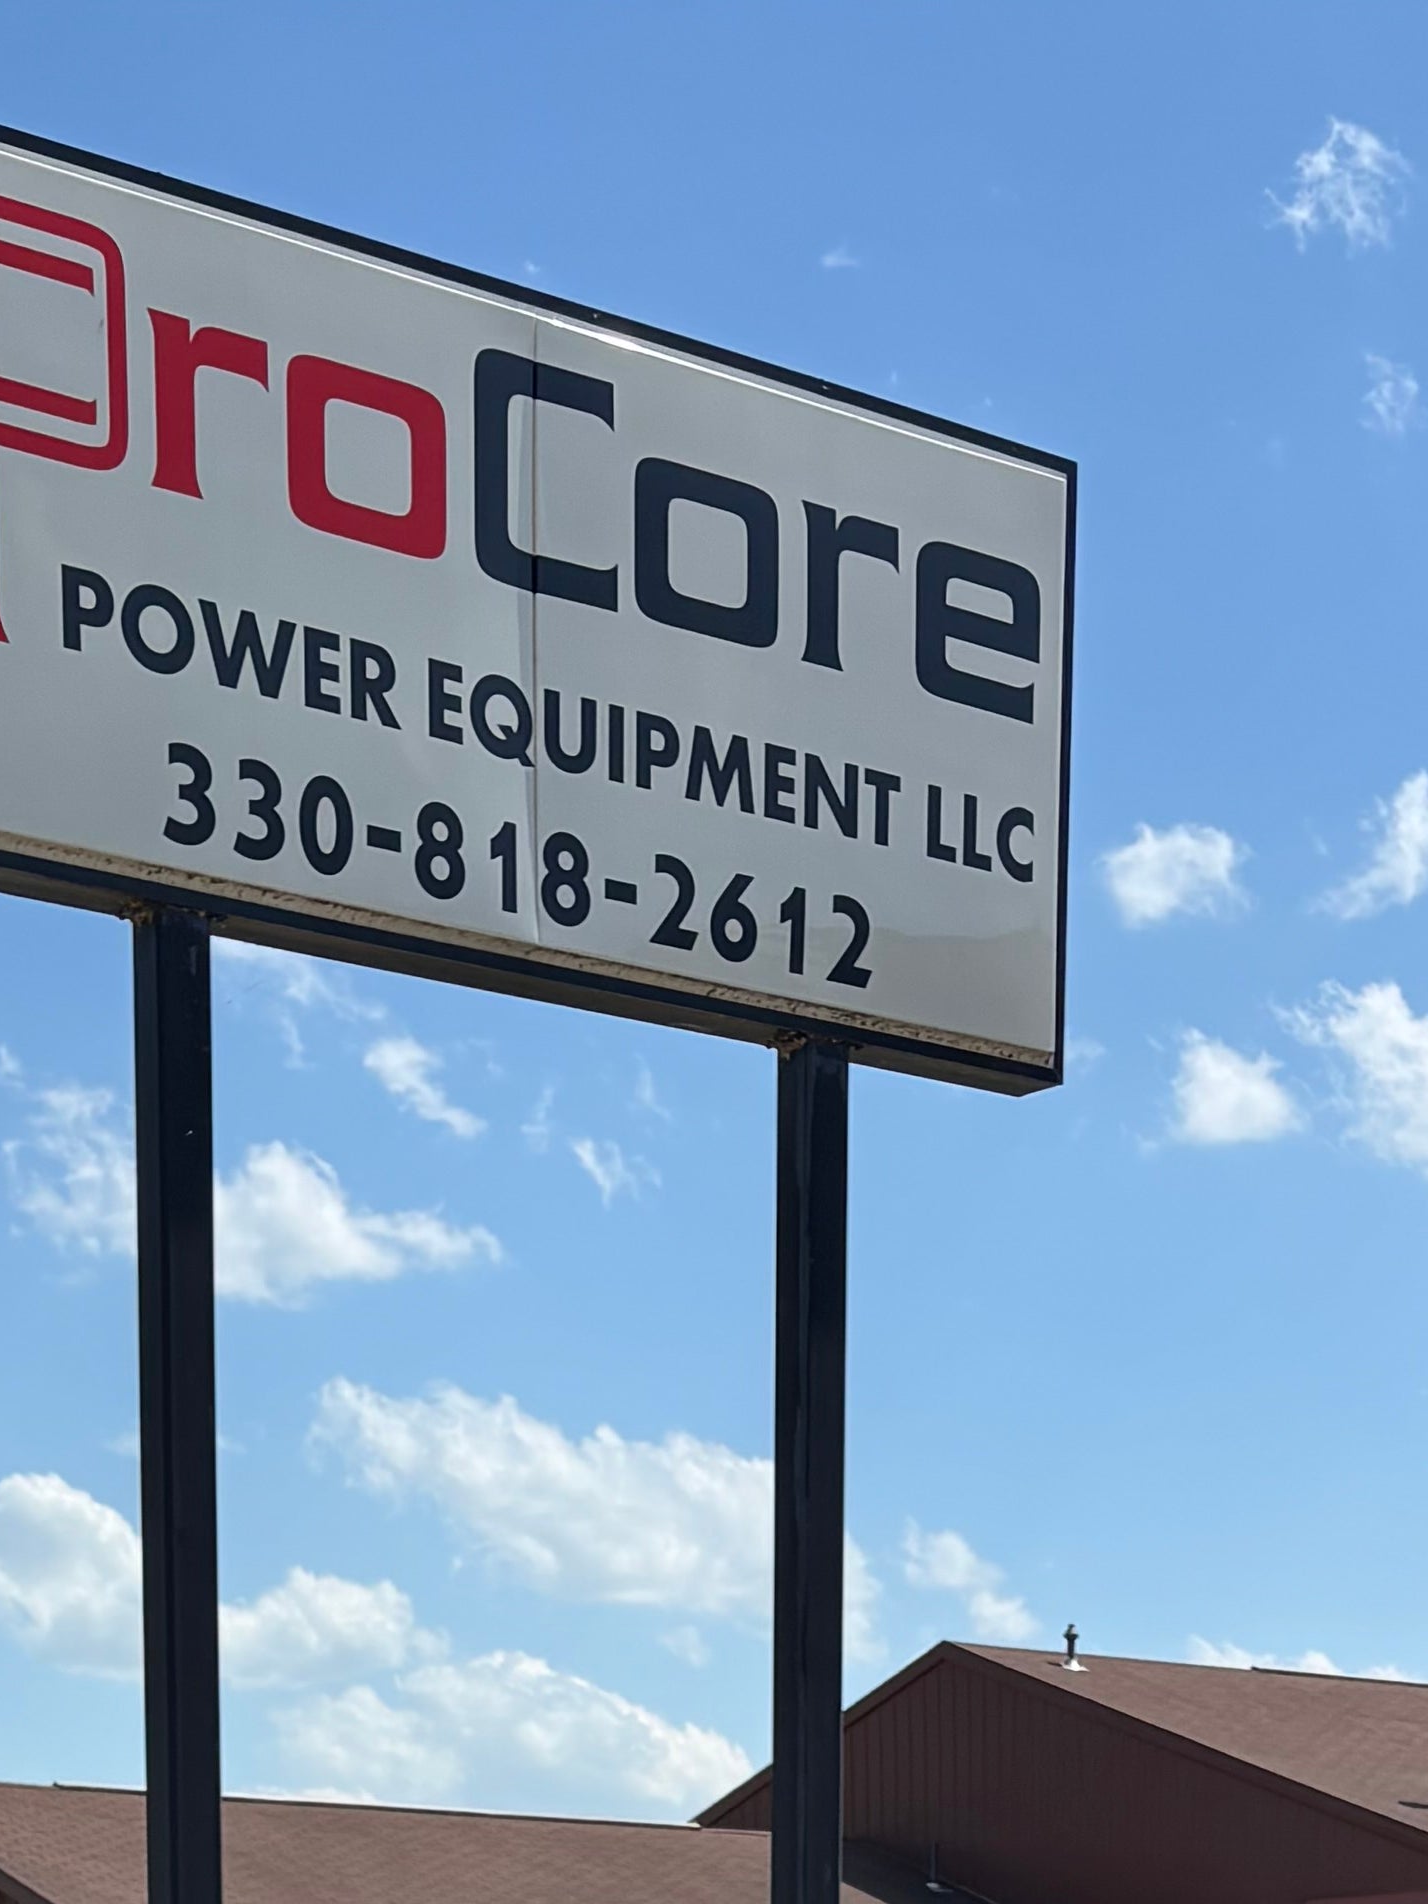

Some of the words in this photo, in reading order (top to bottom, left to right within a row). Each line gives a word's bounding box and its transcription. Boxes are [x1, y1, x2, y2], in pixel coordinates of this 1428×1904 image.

[61, 564, 401, 730] POWER
[429, 659, 901, 847] EQUIPMENT
[926, 785, 1036, 884] LLC
[163, 742, 873, 988] 330-818-2612
